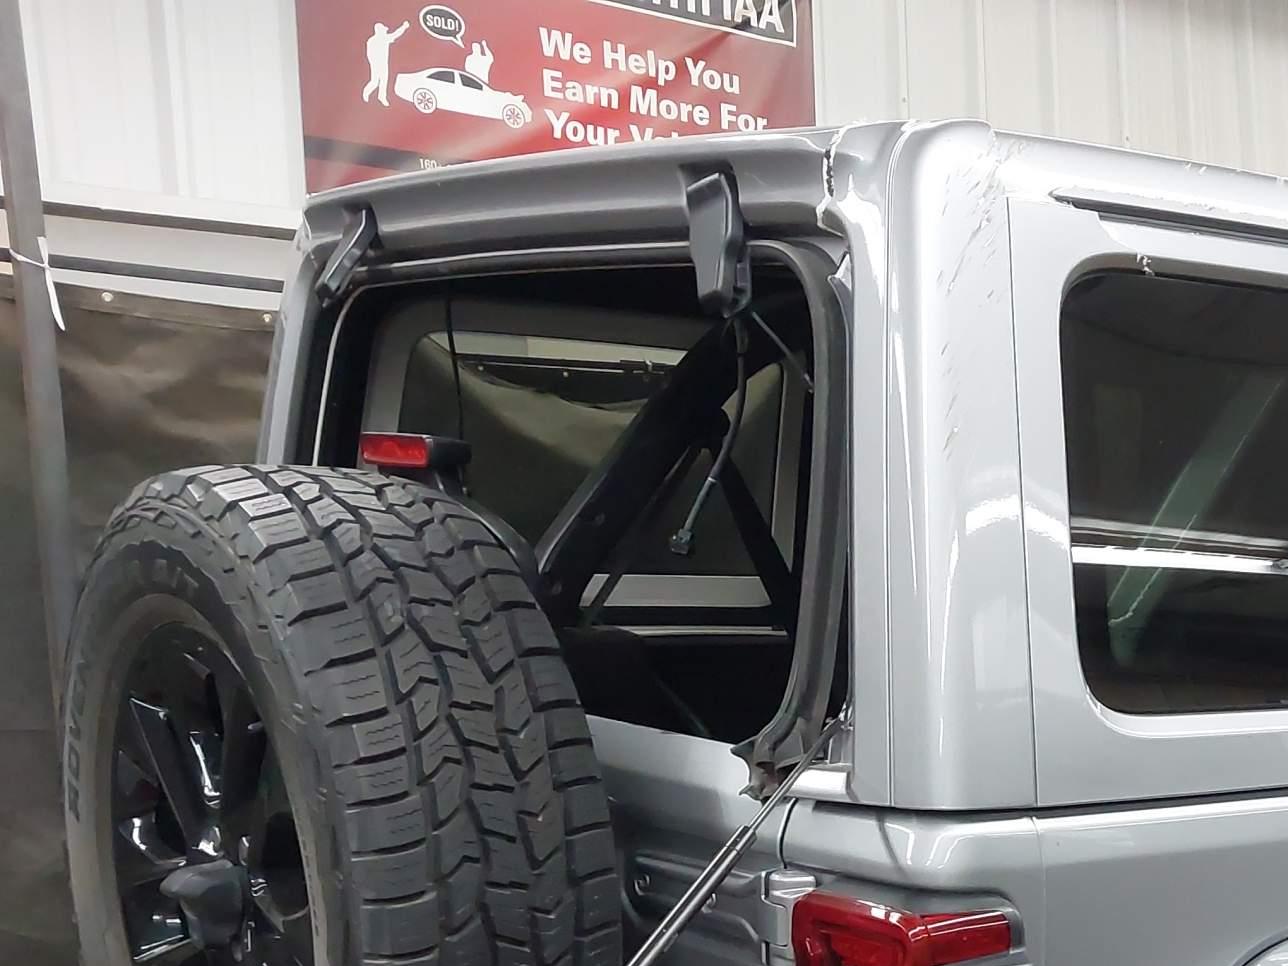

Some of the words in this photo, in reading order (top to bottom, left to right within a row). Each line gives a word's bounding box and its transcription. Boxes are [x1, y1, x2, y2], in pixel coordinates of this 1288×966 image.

[426, 14, 459, 32] SOLD!
[539, 27, 591, 64] We
[603, 40, 676, 85] Help
[685, 57, 740, 95] You
[542, 69, 619, 109] Earn
[630, 85, 710, 126] More
[720, 103, 767, 132] For
[544, 109, 619, 145] Your
